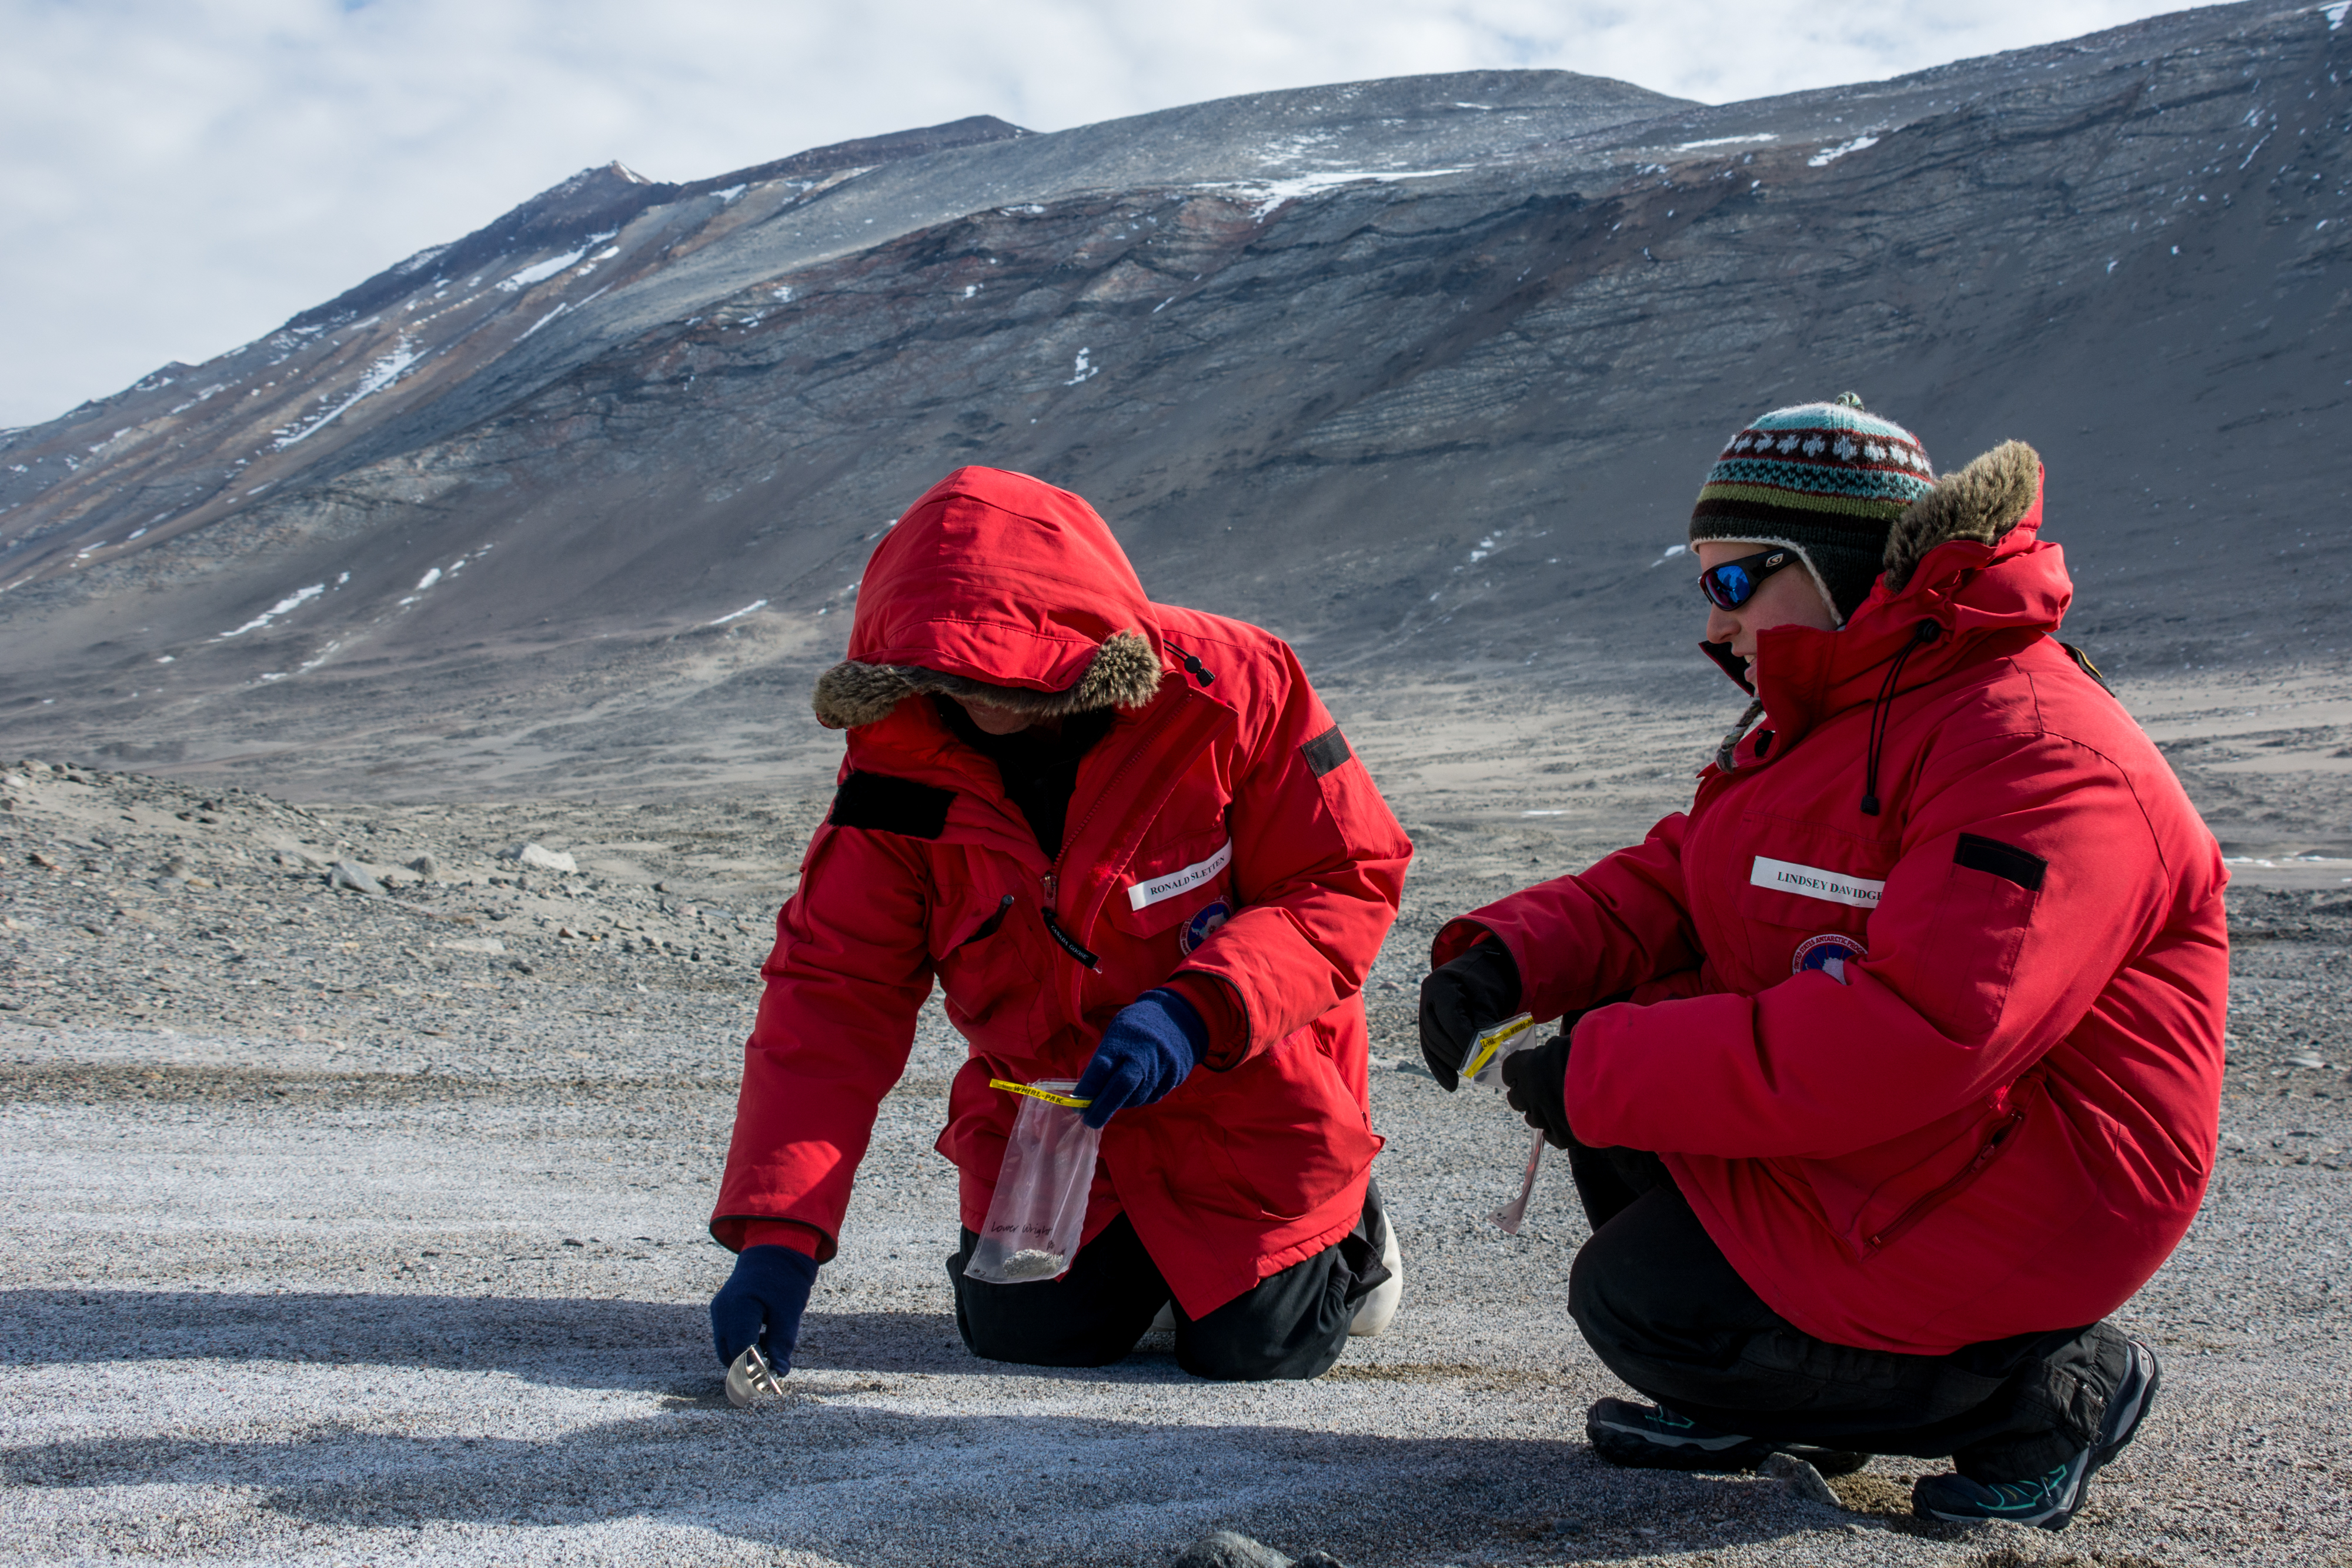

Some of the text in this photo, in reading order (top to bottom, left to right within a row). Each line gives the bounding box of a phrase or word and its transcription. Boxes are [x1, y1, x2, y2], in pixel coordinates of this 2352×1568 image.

[1150, 855, 1225, 895] RONALD SLETTEN
[1777, 871, 1828, 890] LINDSEY
[1051, 925, 1068, 946] CANADA
[1794, 952, 1802, 969] UNITED
[1800, 940, 1815, 954] STATES
[1815, 936, 1847, 944] ANTARCTIC
[991, 1221, 1053, 1238] Lower Wright
